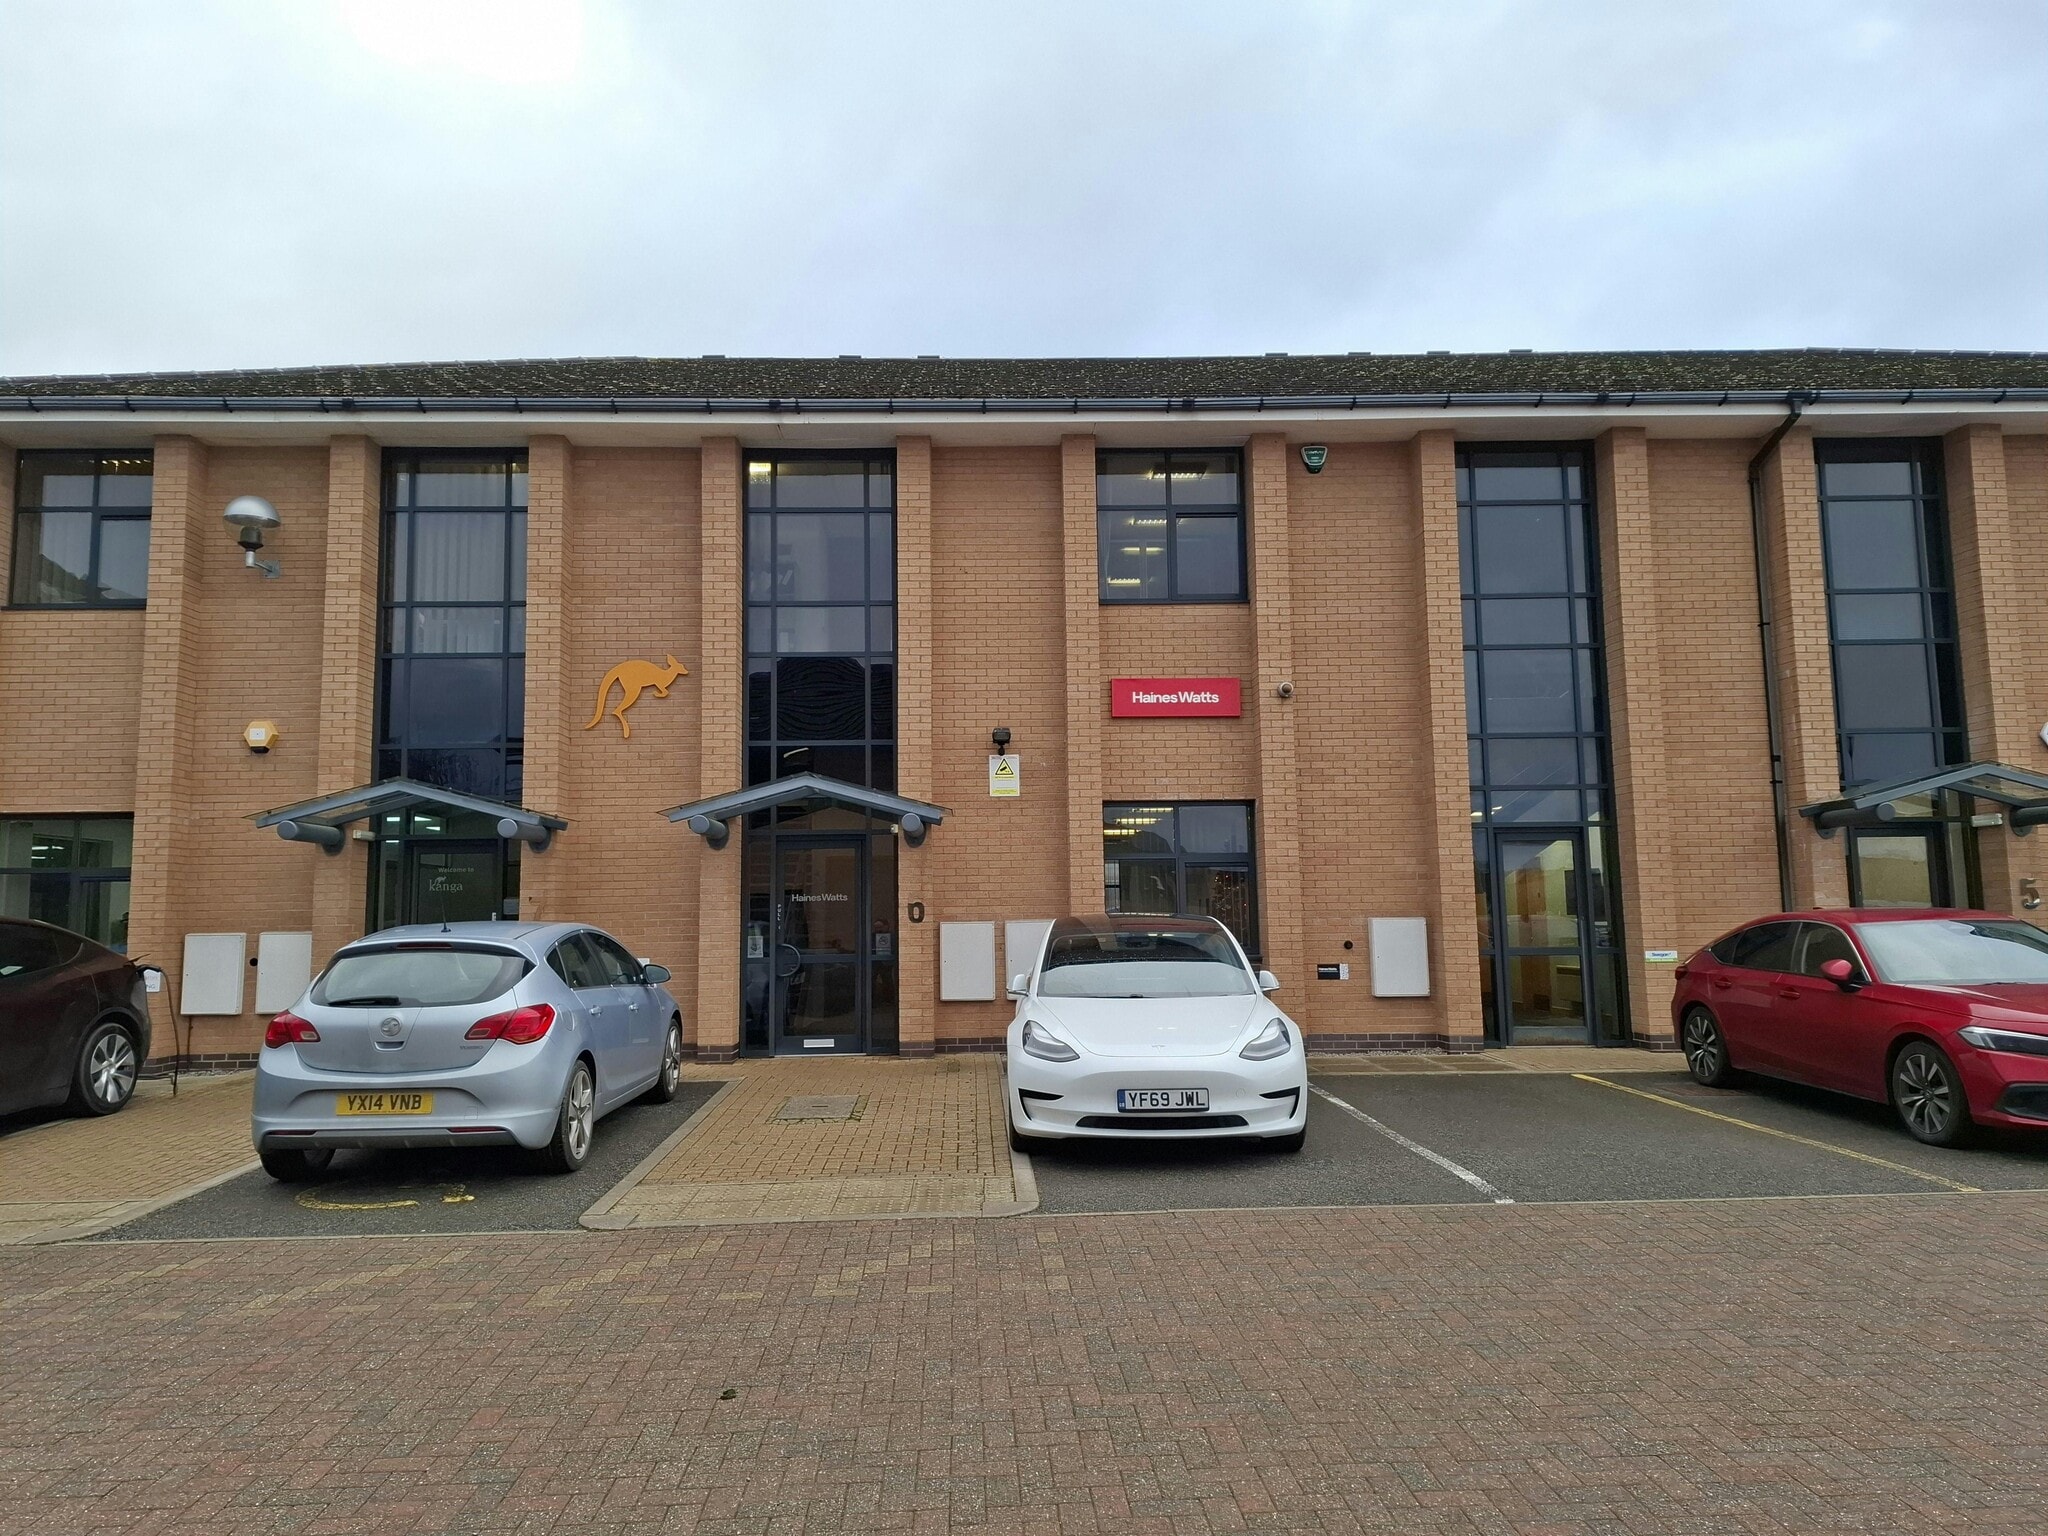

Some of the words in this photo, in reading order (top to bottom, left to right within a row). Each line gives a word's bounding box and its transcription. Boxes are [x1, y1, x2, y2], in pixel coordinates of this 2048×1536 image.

[2020, 878, 2041, 910] 5
[347, 1094, 383, 1111] YX14
[390, 1094, 422, 1110] VNB
[1128, 1092, 1170, 1108] YF69
[1175, 1091, 1205, 1107] JWL
